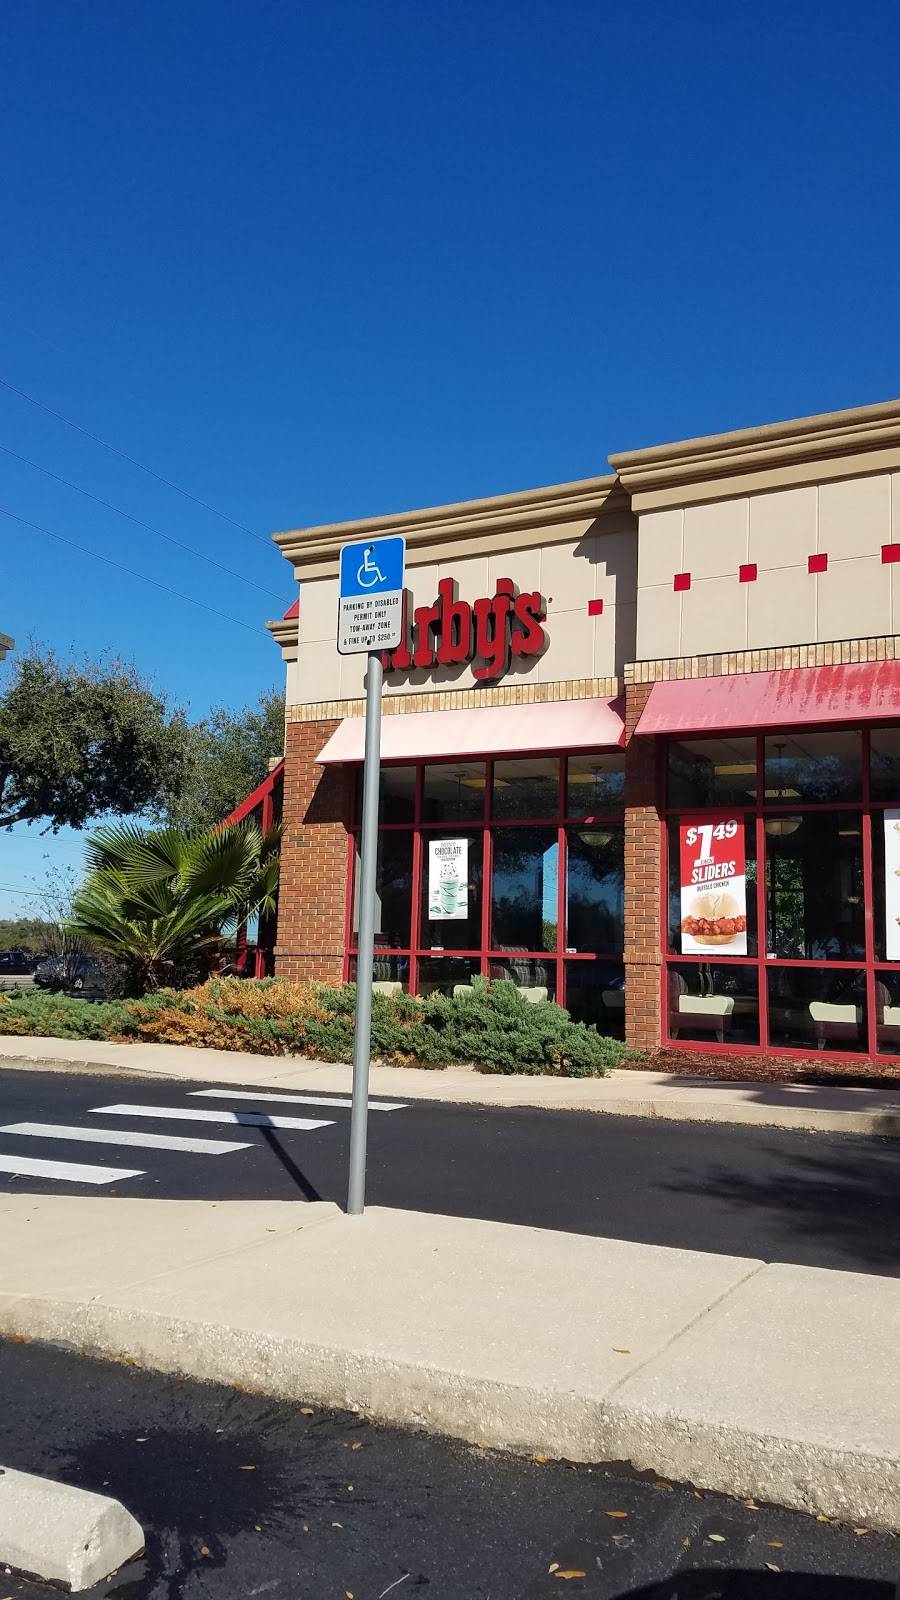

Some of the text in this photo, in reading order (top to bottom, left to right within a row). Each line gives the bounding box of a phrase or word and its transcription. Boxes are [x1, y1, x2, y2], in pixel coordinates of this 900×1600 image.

[344, 602, 364, 610] PARKING
[375, 598, 398, 607] DISABLED
[354, 612, 372, 621] PERMIT
[350, 621, 390, 632] TOW-AWAY ZONE
[435, 847, 462, 855] CHOCOLATE
[691, 860, 736, 884] SLIDERS
[697, 883, 712, 892] BUFFALO
